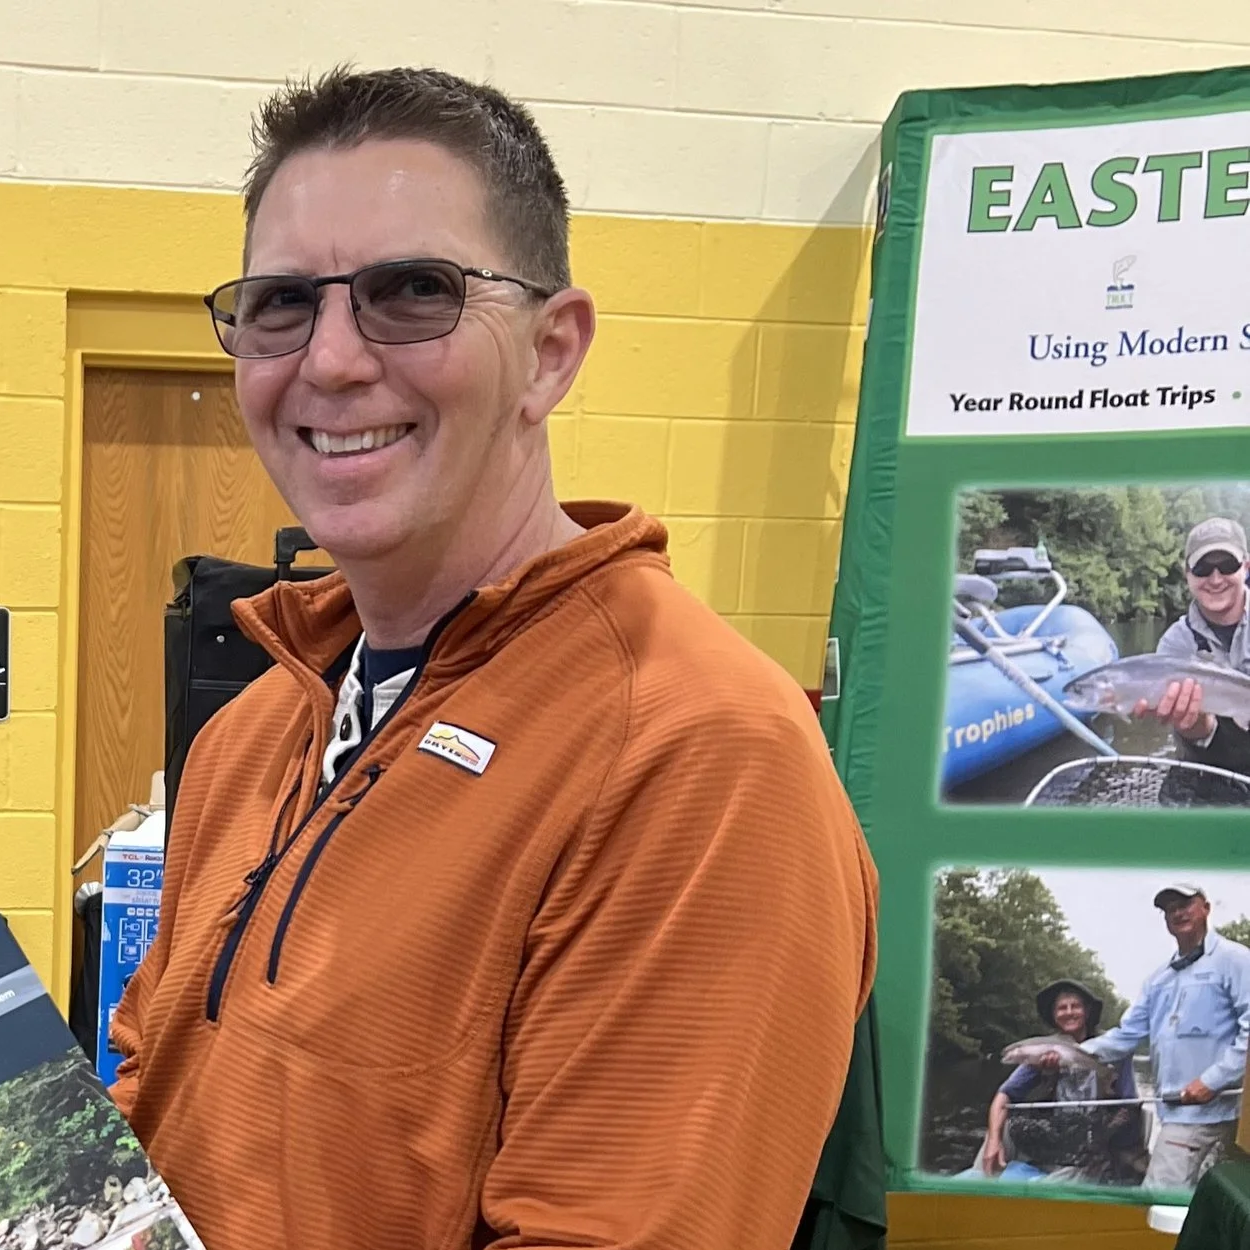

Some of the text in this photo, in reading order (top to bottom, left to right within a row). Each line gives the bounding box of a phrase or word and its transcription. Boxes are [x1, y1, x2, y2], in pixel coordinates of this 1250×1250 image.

[967, 146, 1250, 233] EASTE
[1029, 334, 1108, 367] Using
[1117, 326, 1228, 357] Modern
[950, 383, 1216, 412] Year Round Float Trips
[124, 922, 141, 931] HD
